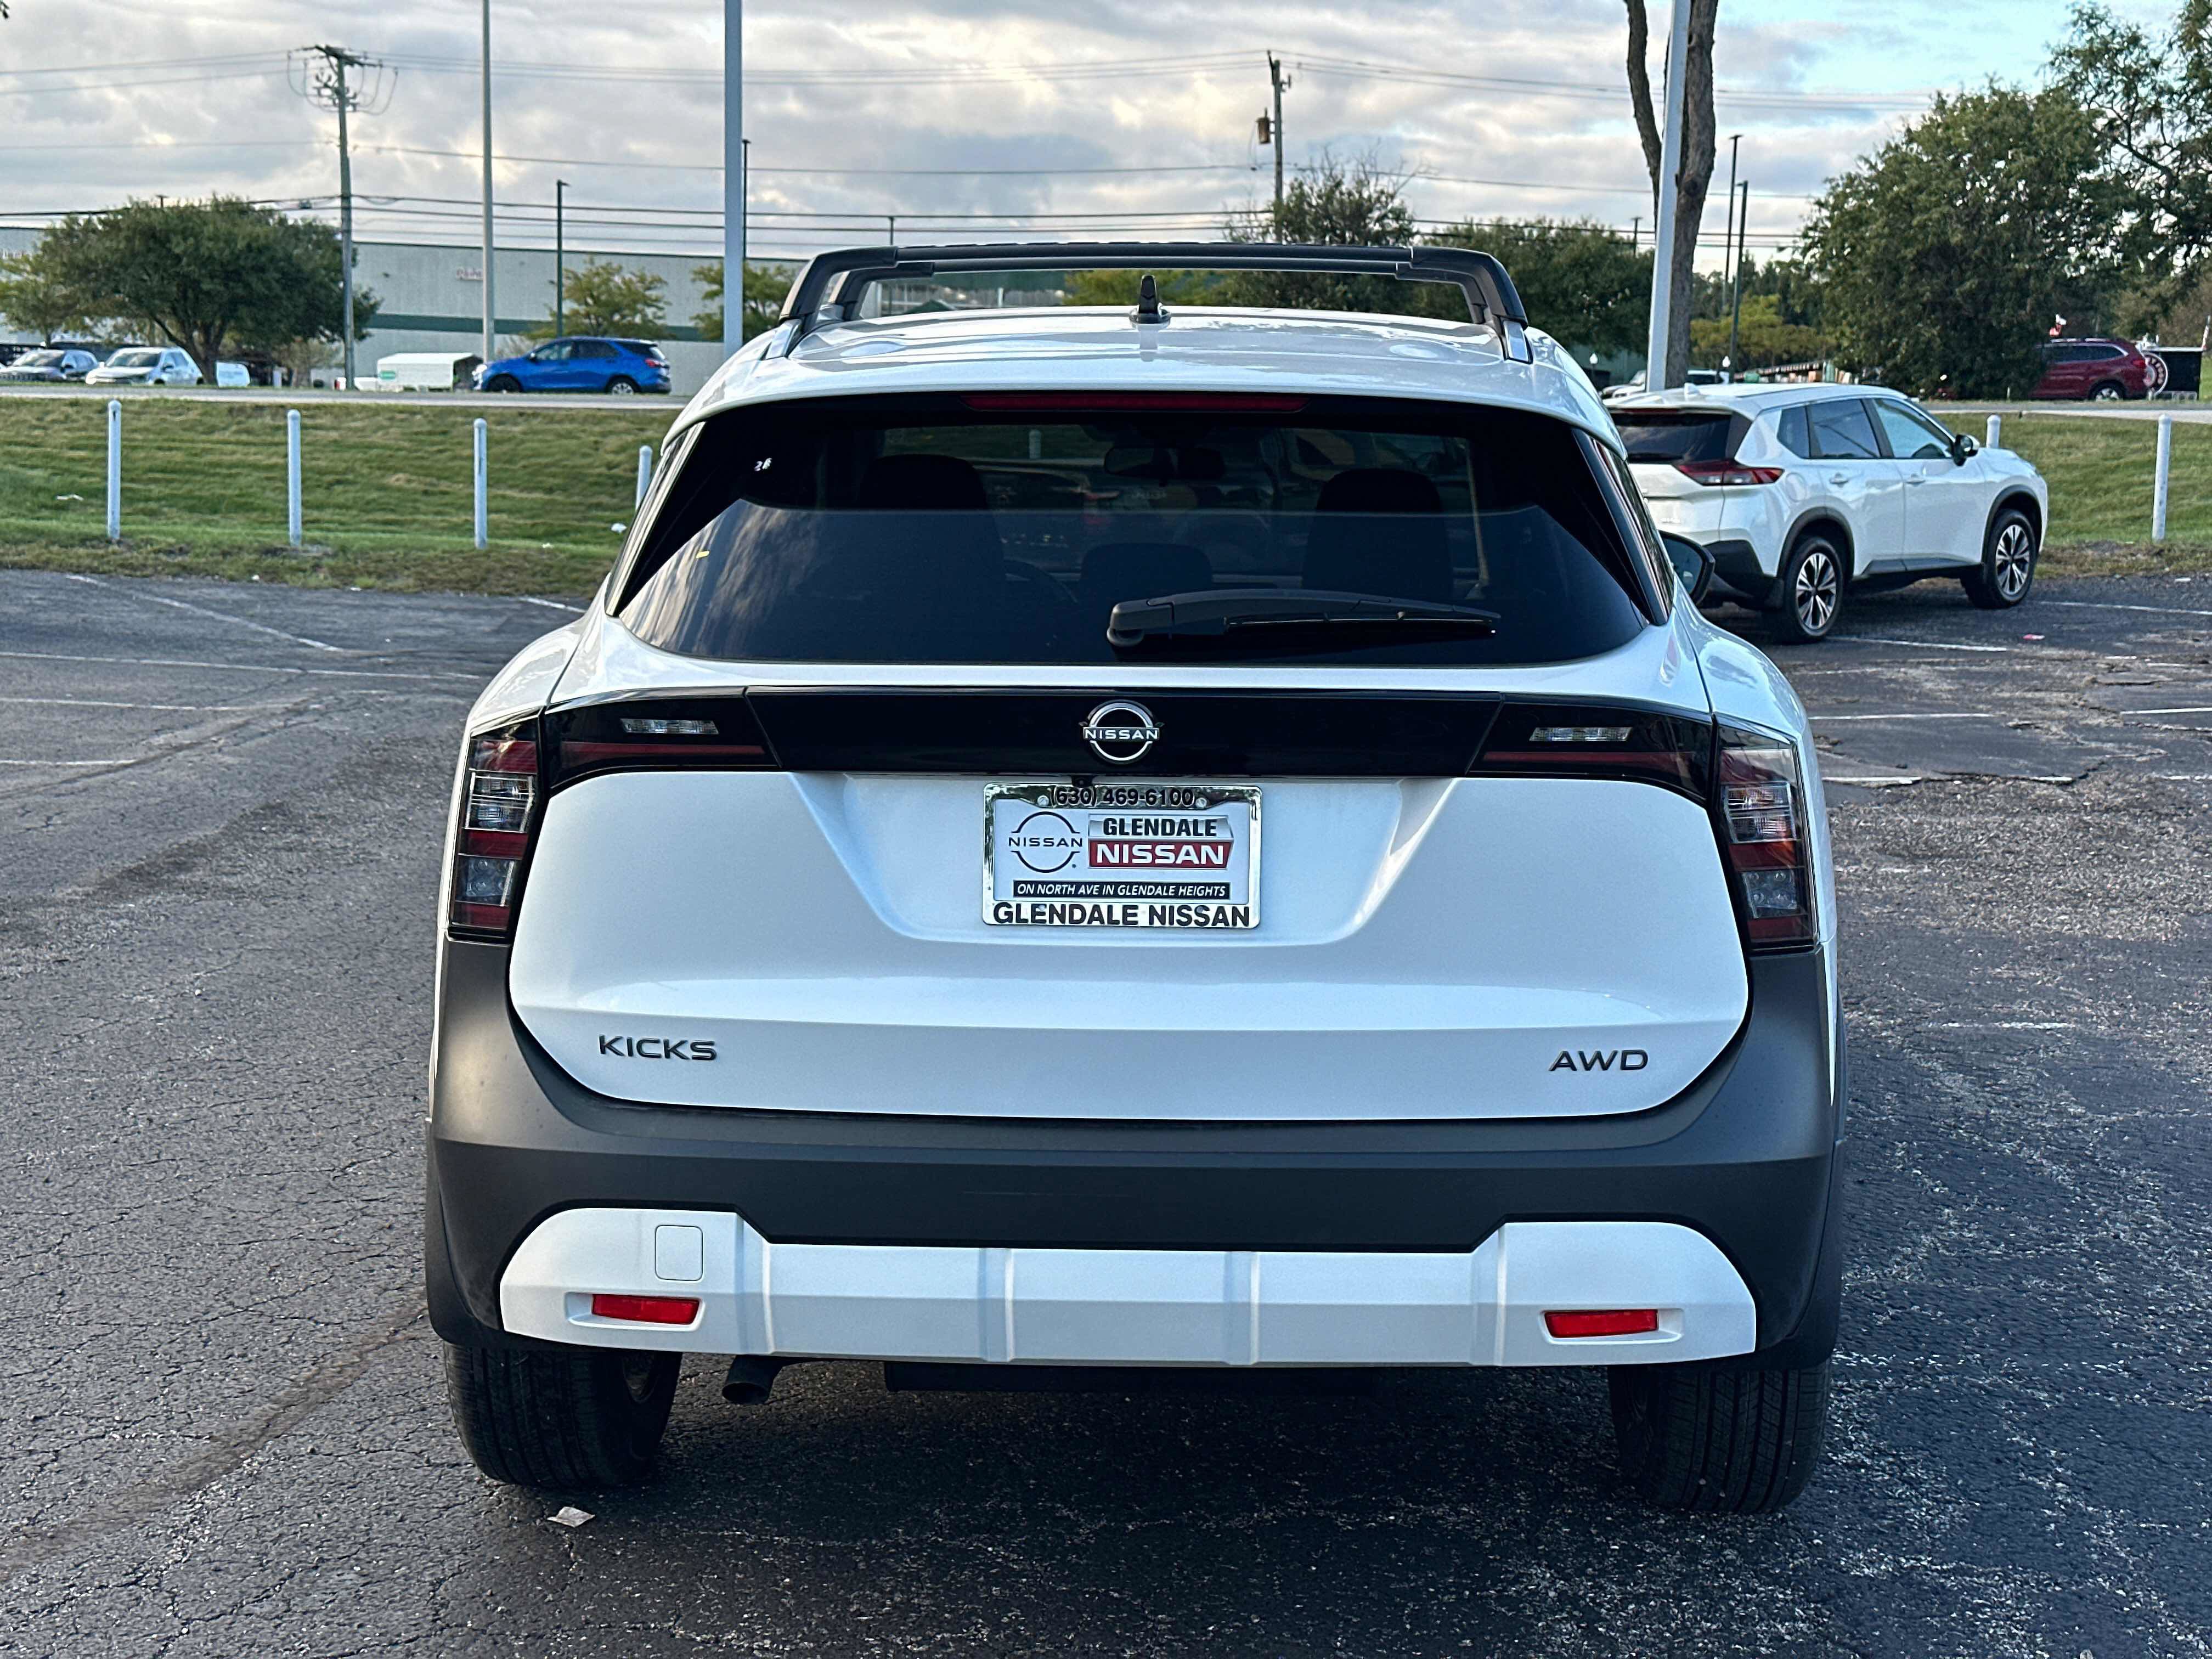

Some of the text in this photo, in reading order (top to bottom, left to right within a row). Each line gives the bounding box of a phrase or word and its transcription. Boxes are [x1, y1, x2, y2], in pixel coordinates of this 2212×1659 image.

[1085, 729, 1158, 740] NISSAN
[1051, 786, 1195, 808] (630) 469-6100
[1103, 818, 1217, 837] GLENDALE
[1008, 837, 1083, 847] NISSAN
[1097, 844, 1223, 865] NISSAN
[1017, 884, 1226, 896] ON NORTH AVE IN GLENDALE HEIGHTS
[993, 902, 1250, 927] GLENDALE NISSAN
[599, 1035, 718, 1061] KICKS
[1549, 1049, 1649, 1071] AWD
